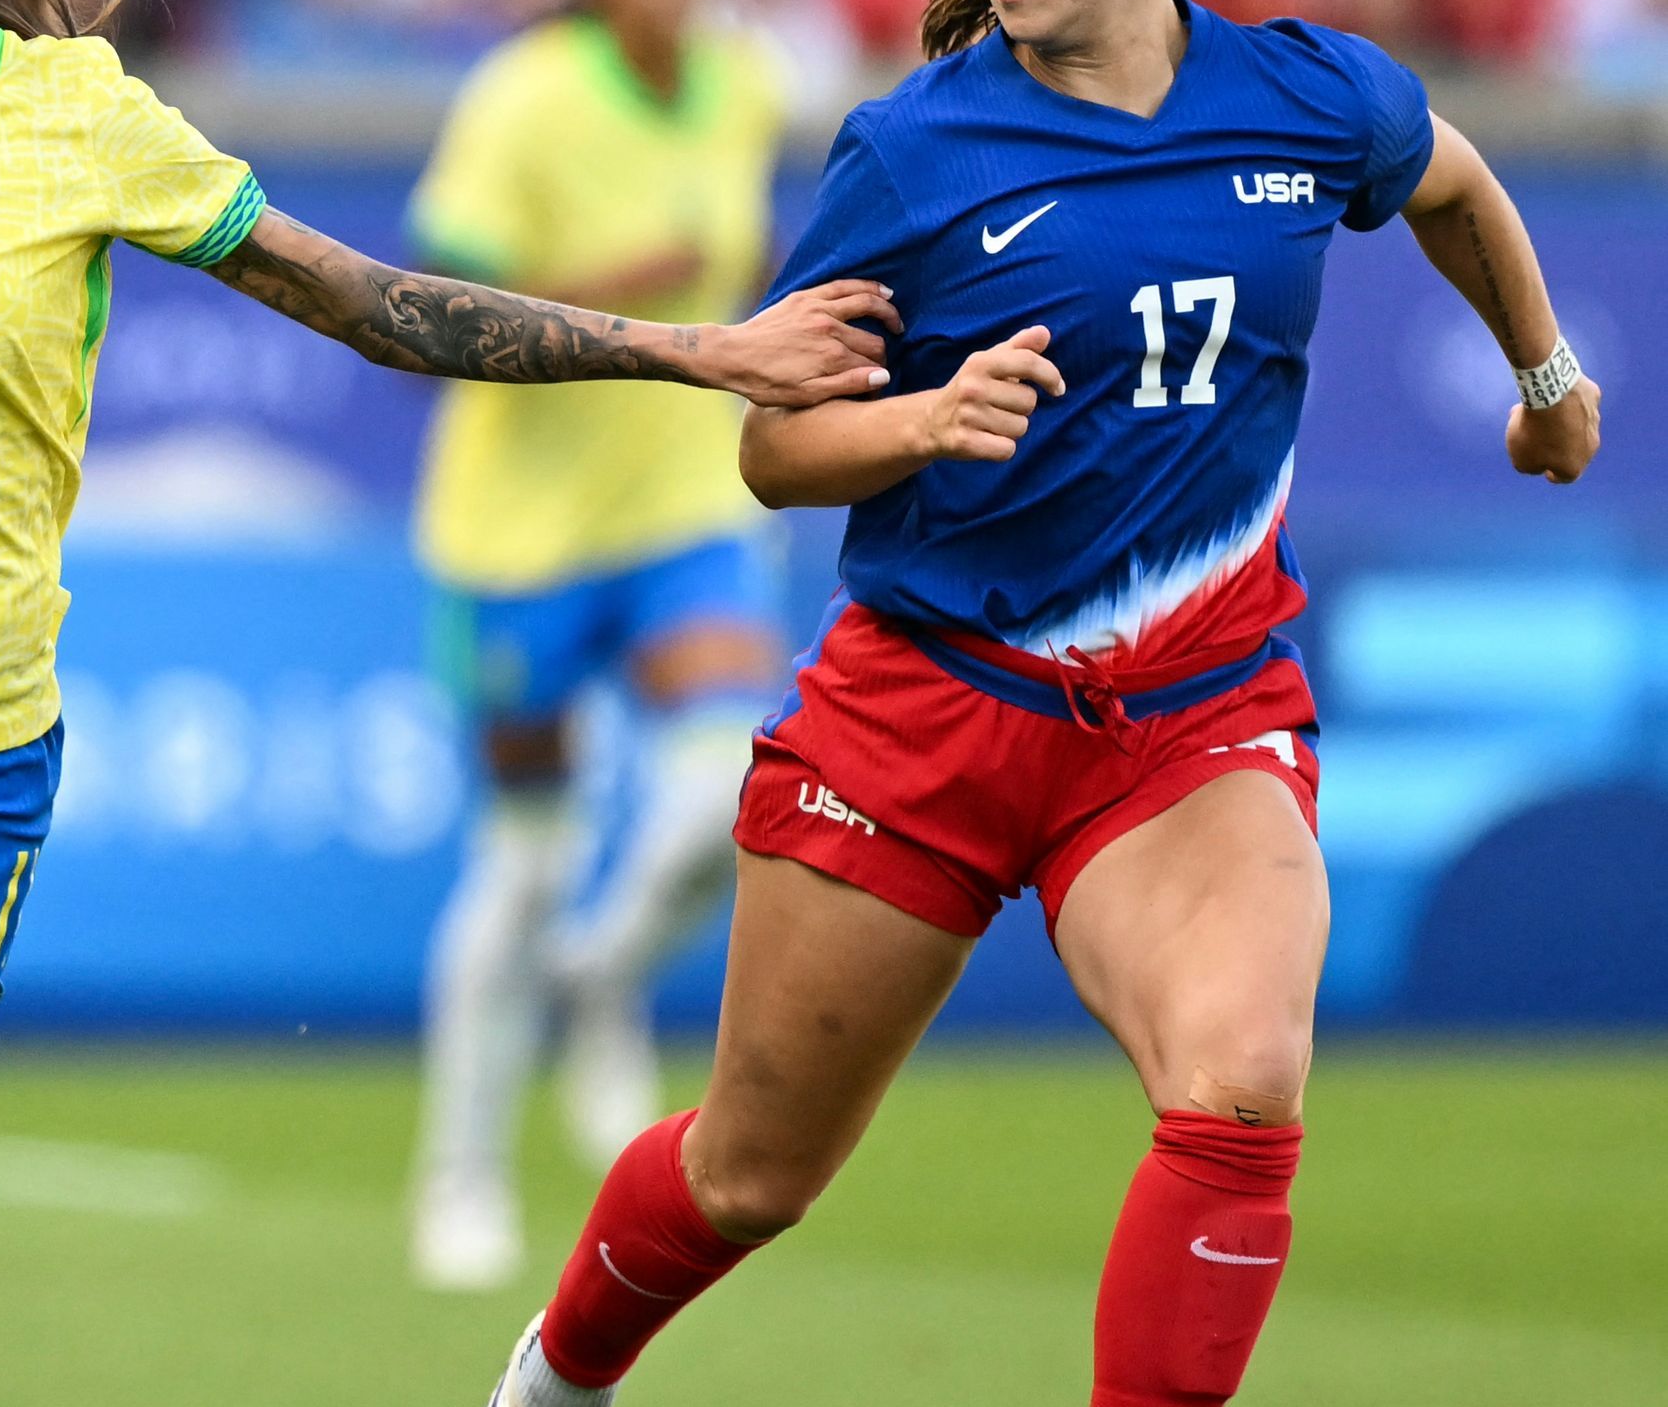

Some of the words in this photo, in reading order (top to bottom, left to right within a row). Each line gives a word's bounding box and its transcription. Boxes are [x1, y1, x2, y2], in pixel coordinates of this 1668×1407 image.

[1232, 172, 1316, 205] USA
[1129, 275, 1237, 409] 17
[797, 780, 878, 837] USA
